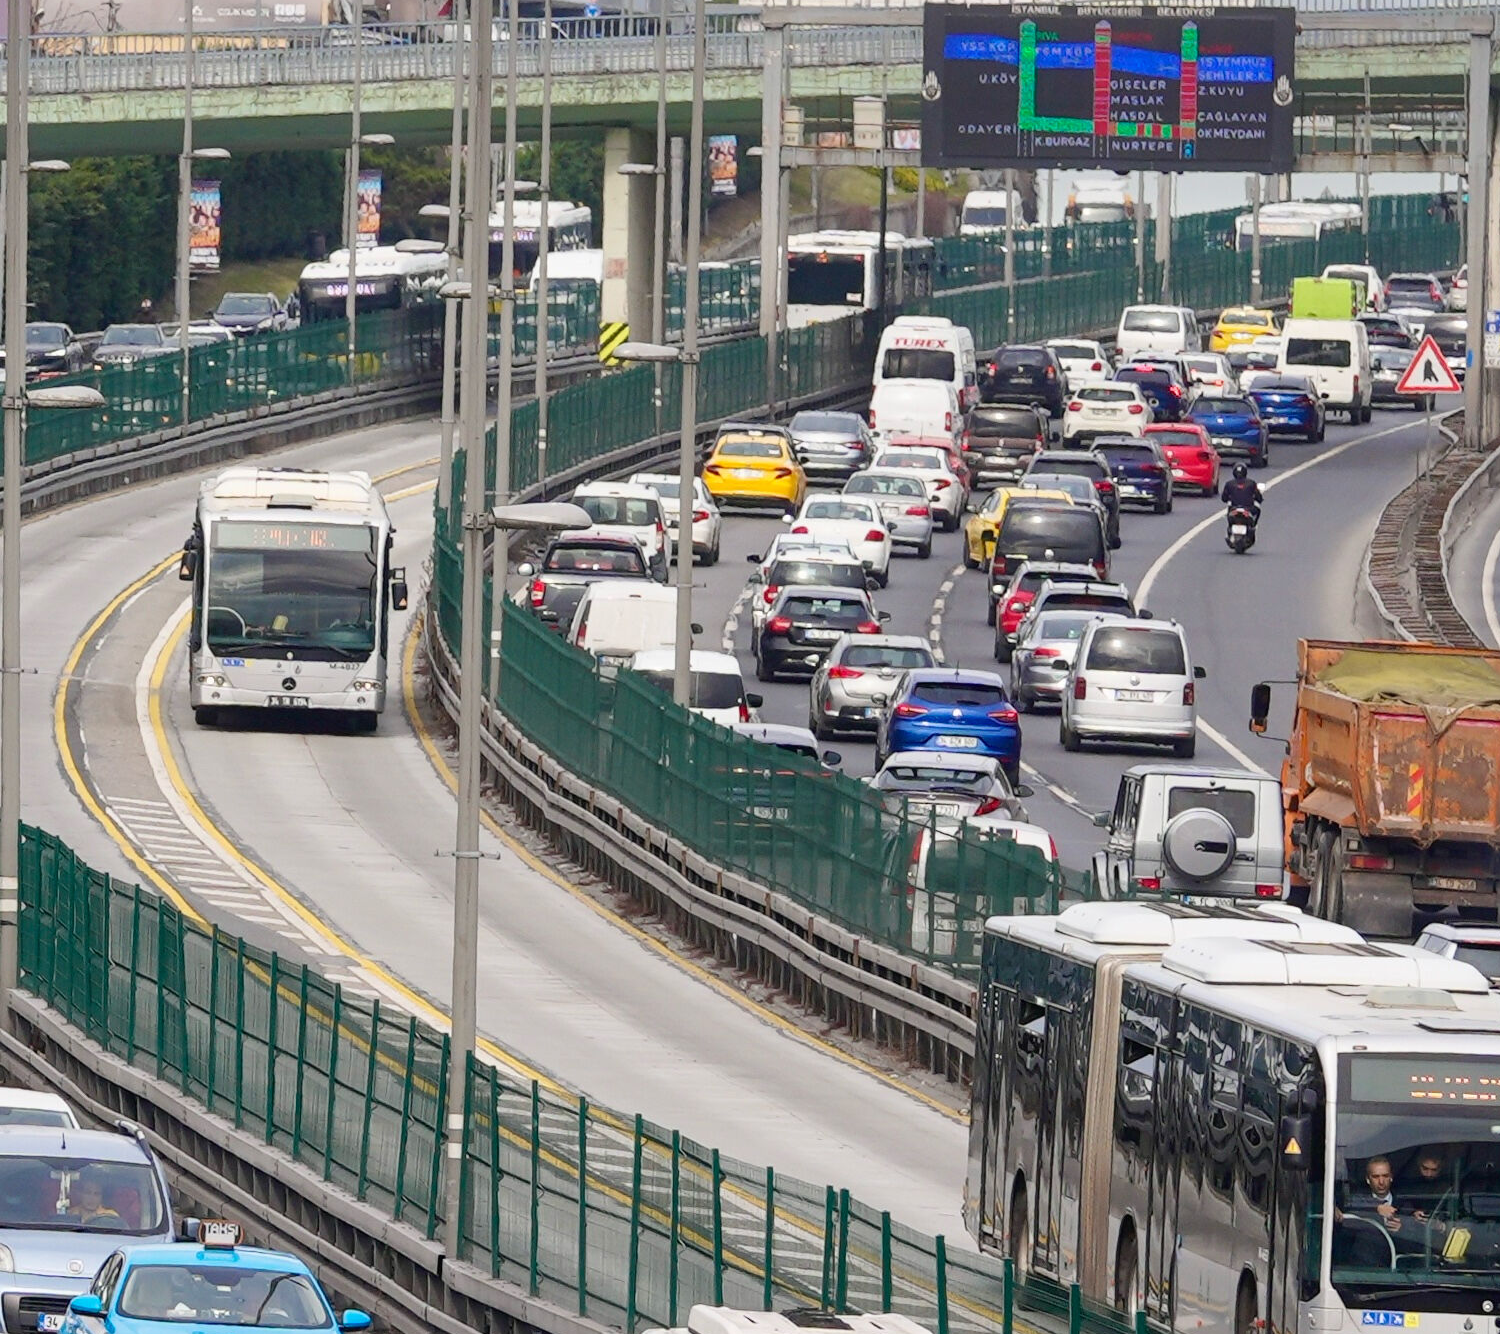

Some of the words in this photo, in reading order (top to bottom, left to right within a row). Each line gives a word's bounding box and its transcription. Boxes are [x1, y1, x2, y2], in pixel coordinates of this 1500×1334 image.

[1217, 56, 1267, 67] TEMMUZ
[1197, 127, 1266, 140] OKMEYDANI
[1035, 135, 1091, 148] K.BURGAZ
[1111, 140, 1173, 152] NURTEPE
[894, 338, 948, 349] TUREX
[46, 1315, 58, 1328] 34
